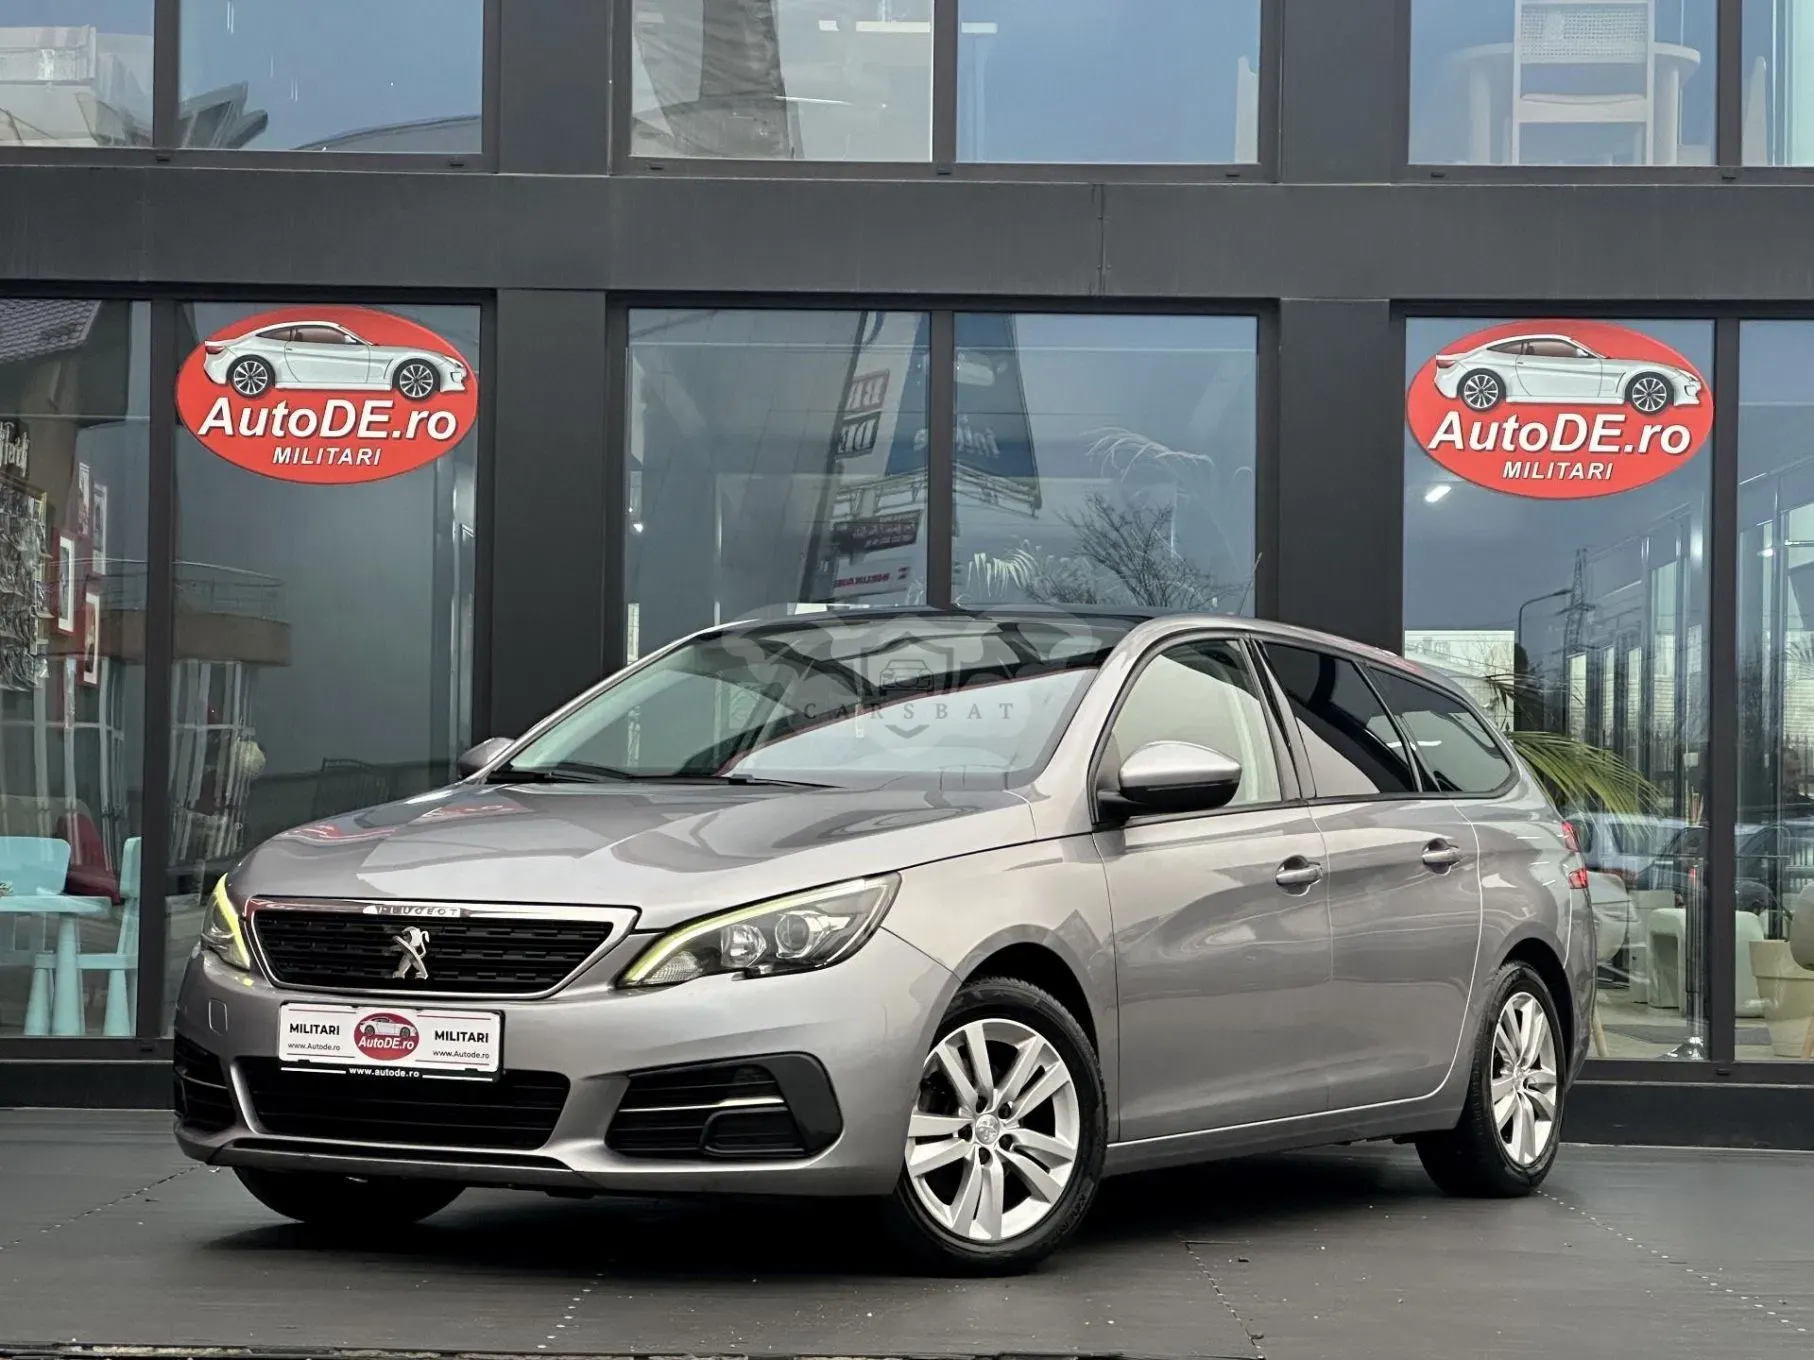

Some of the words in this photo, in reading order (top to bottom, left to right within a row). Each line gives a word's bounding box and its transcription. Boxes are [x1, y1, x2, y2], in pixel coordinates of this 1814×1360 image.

[197, 396, 458, 440] AutoDE.ro
[1428, 410, 1692, 455] AutoDE.ro
[272, 446, 381, 466] MILITARI
[1503, 461, 1613, 481] MILITARI
[289, 1023, 340, 1036] MILITARI
[358, 1036, 415, 1050] AutoDE.ro
[434, 1030, 489, 1043] MILITARI
[287, 1042, 341, 1051] www.Autode.ro
[432, 1049, 490, 1060] www.Autode.ro
[349, 1067, 420, 1078] www.autode.ro
